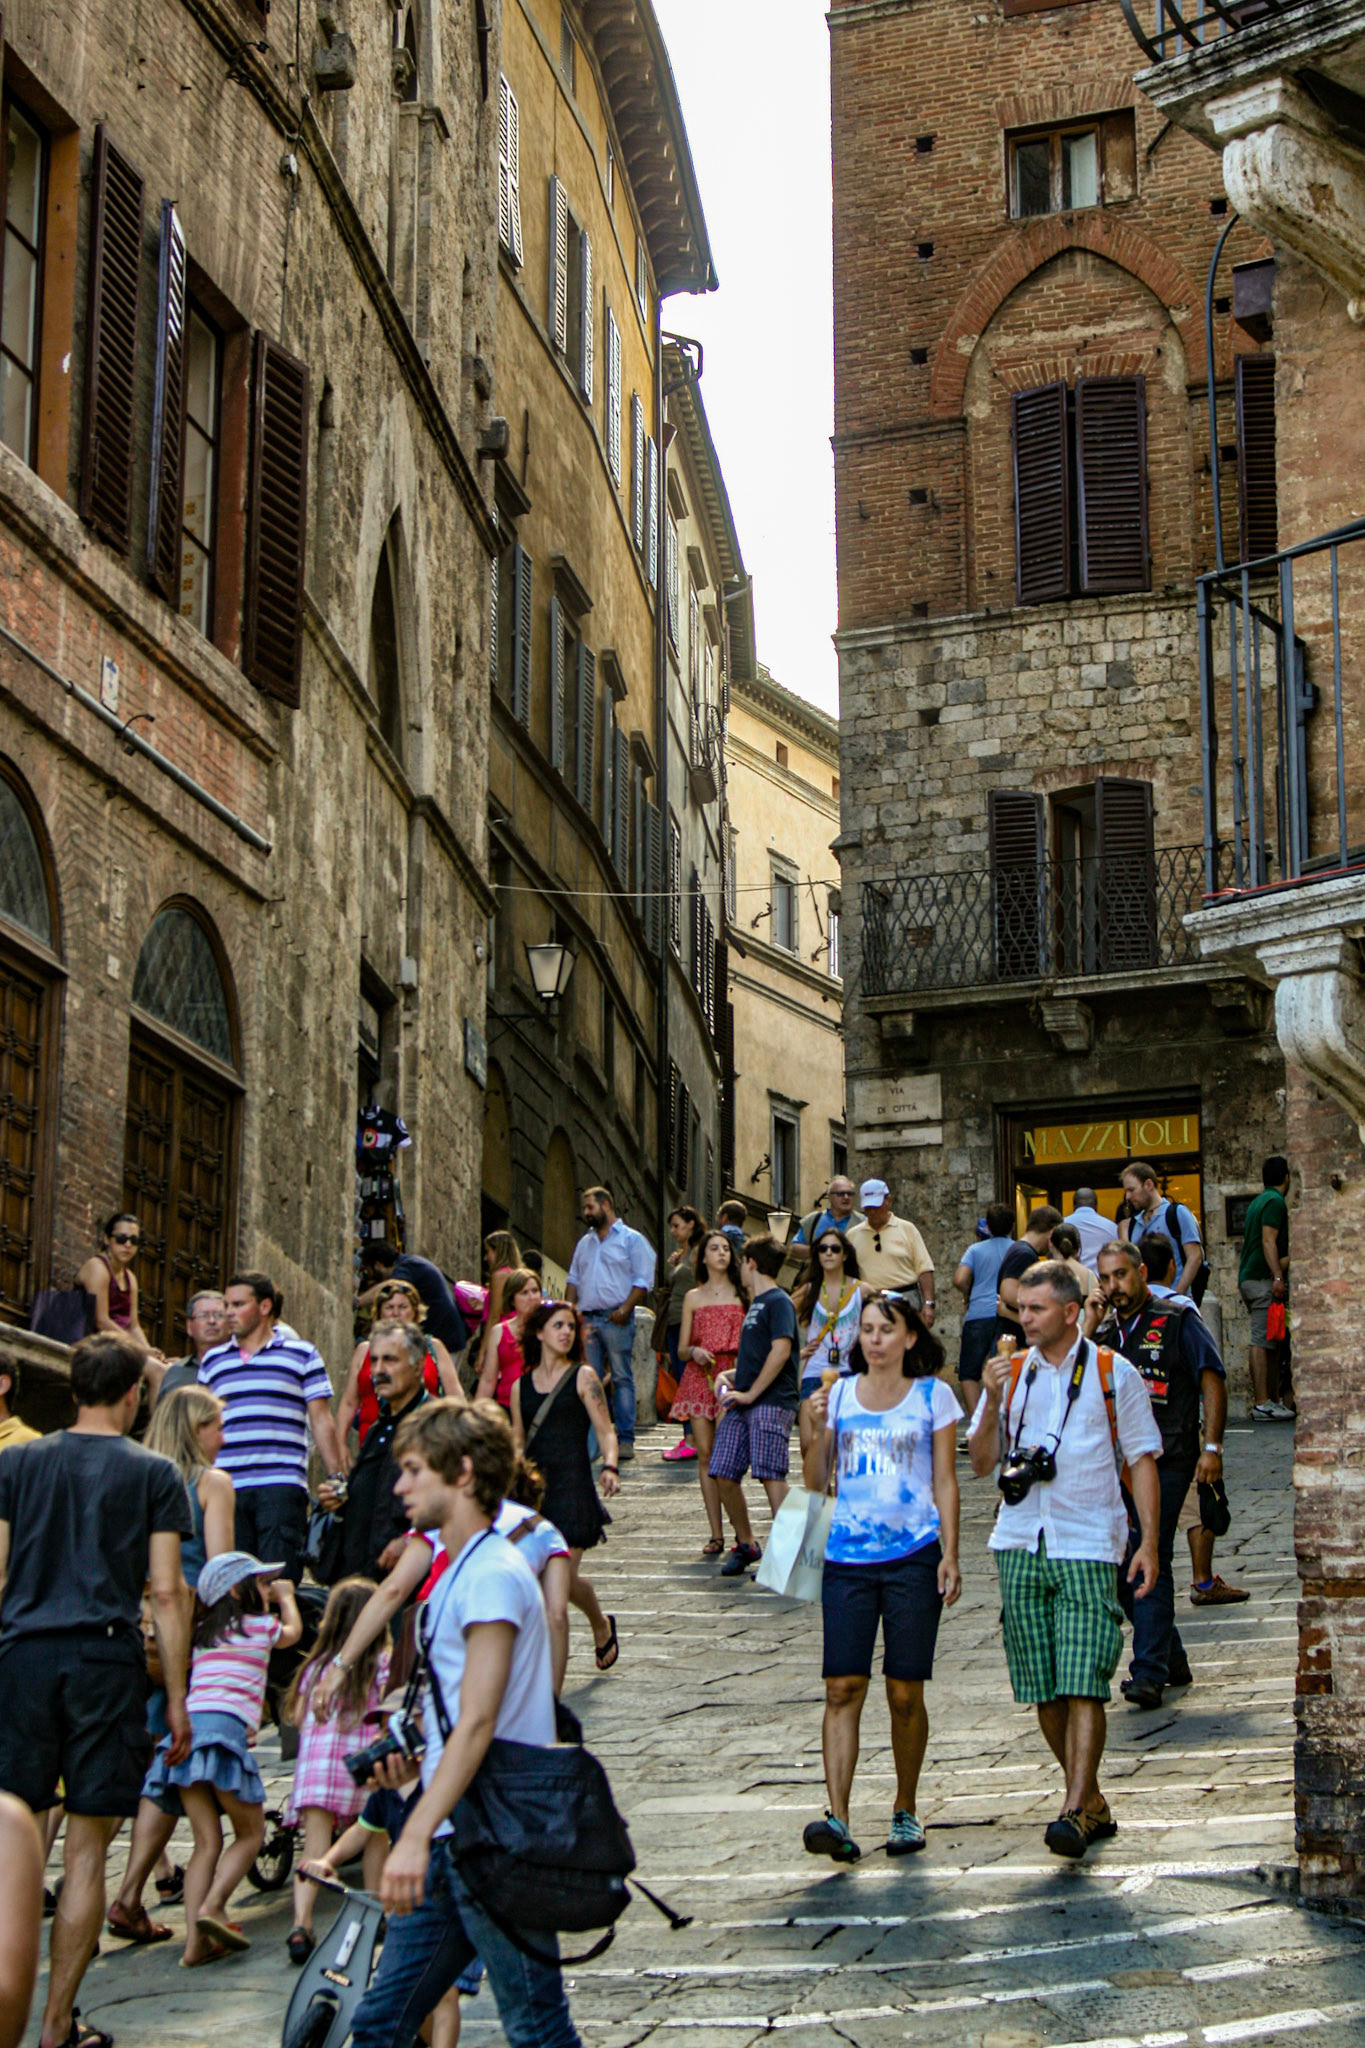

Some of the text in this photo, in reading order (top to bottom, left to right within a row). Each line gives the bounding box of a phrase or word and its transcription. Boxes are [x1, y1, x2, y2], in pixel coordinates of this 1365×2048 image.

[890, 1087, 905, 1095] VIA
[877, 1105, 886, 1114] DI
[1023, 1117, 1190, 1158] MAZZUOLI
